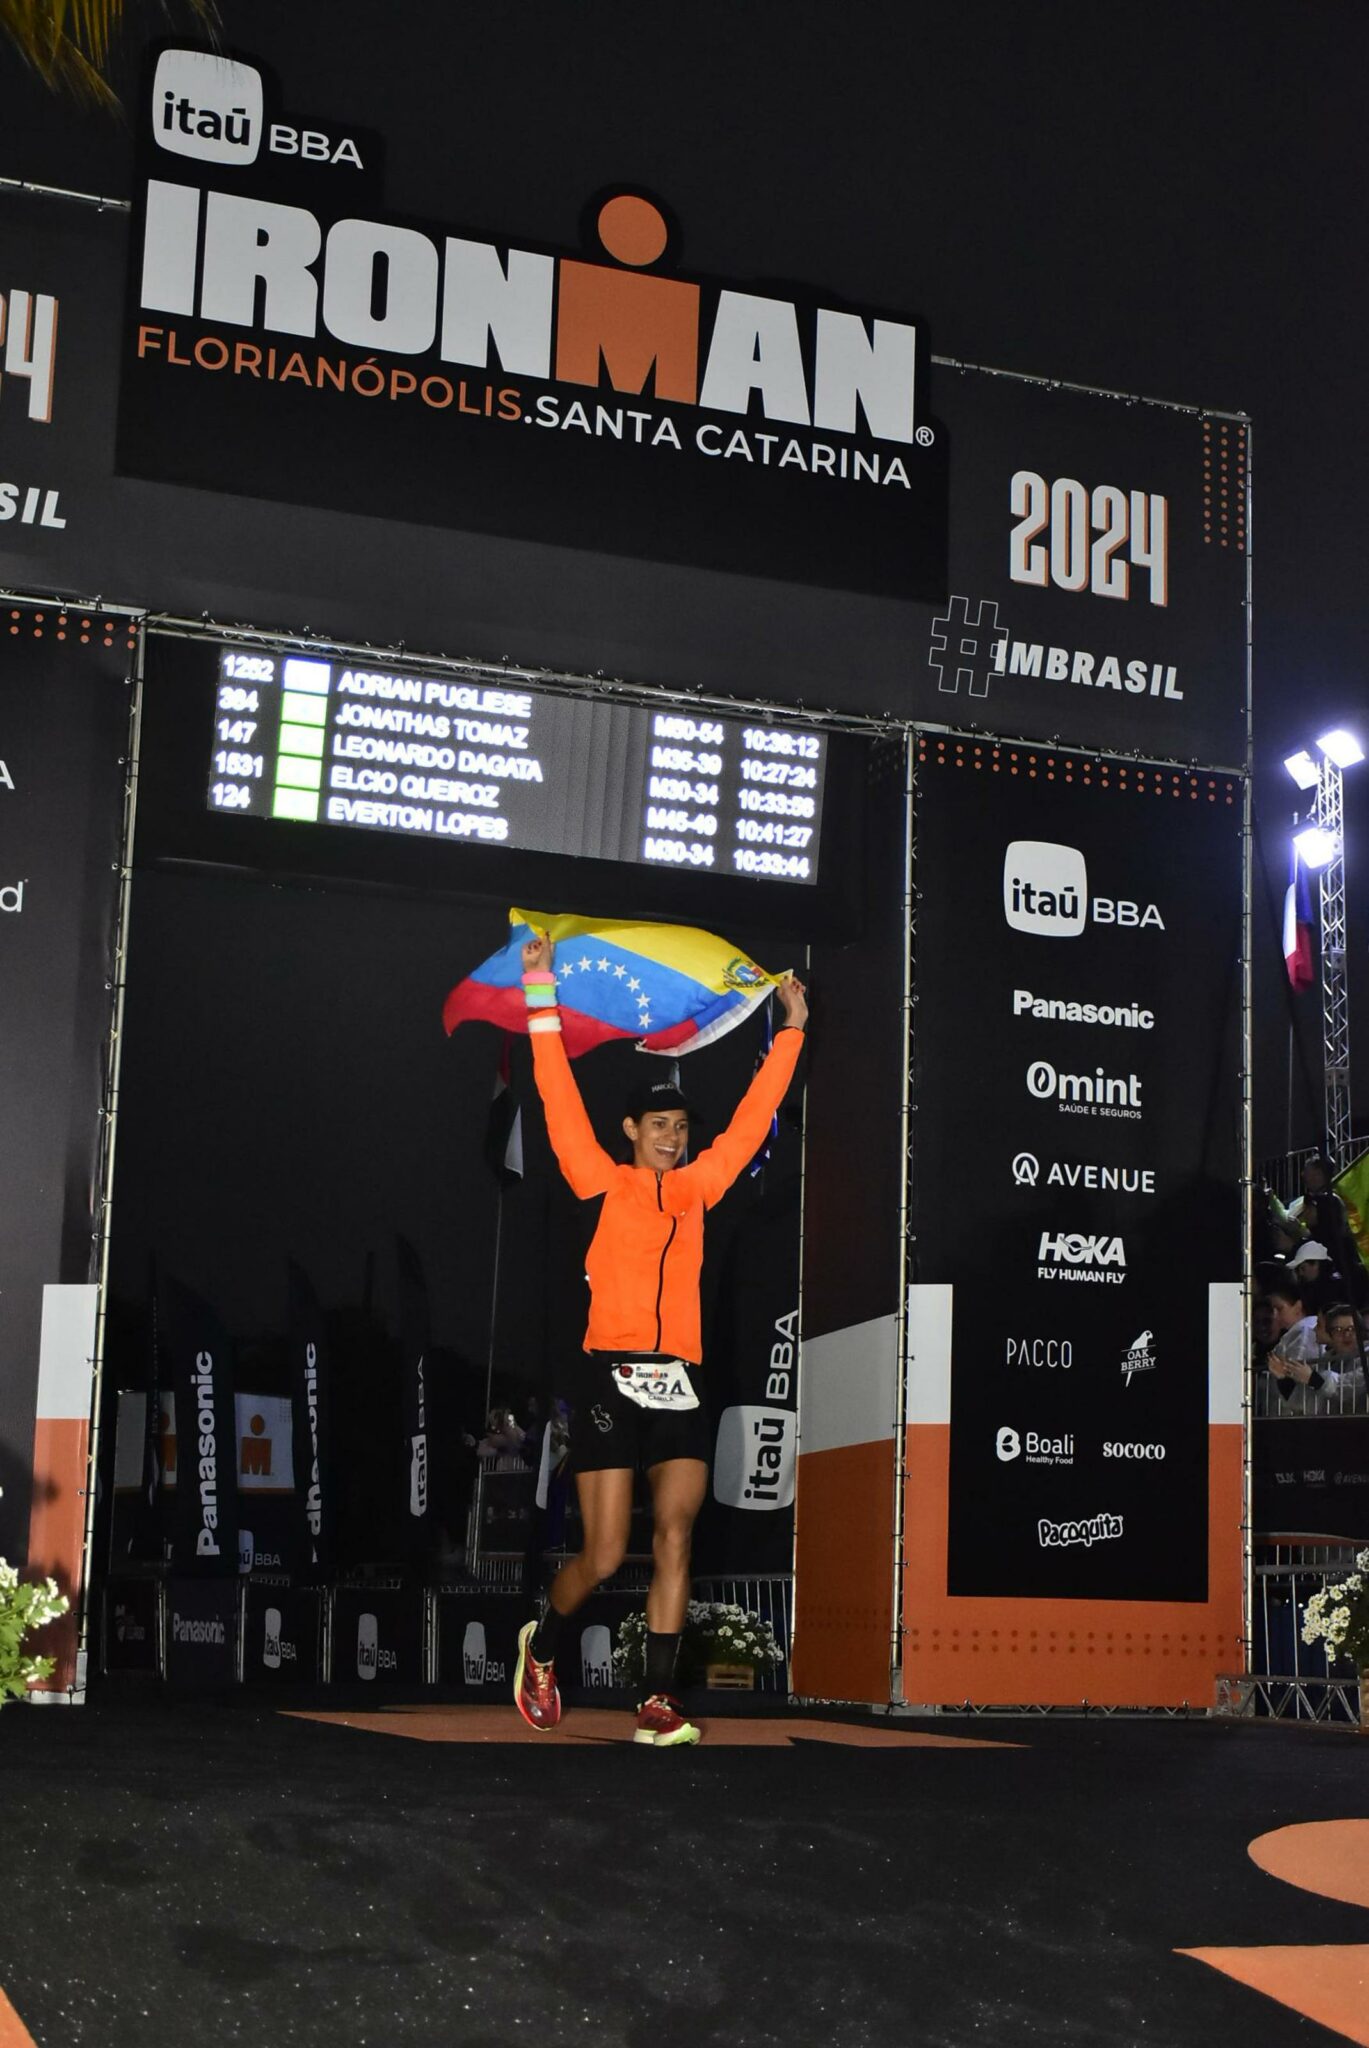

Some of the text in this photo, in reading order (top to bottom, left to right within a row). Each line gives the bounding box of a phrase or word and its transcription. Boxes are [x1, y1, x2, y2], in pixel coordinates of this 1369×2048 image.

[269, 125, 364, 169] BBA
[140, 178, 917, 445] IRONMAN
[695, 424, 912, 490] CATARINA
[1009, 470, 1168, 608] 2024
[336, 671, 422, 703] ADRIAN
[335, 703, 451, 739] JONATHAS
[452, 717, 529, 750] TOMAZ
[217, 718, 258, 744] 147
[332, 734, 455, 771] LEONARDO
[458, 750, 544, 783] DAGATA
[211, 782, 252, 810] 124
[327, 797, 432, 832] EVERTON
[434, 810, 510, 841] LOPES
[330, 765, 398, 795] ELCIO
[400, 775, 500, 809] QUEIROZ
[735, 819, 813, 849] 10:41:27
[1011, 877, 1166, 930] itaú BBA
[1012, 988, 1155, 1030] Panasonic
[1099, 1107, 1143, 1120] SEGUROS
[1046, 1162, 1156, 1194] AVENUE
[1037, 1231, 1127, 1267] HOKA
[1037, 1267, 1127, 1285] FLY HUMAN FLY
[765, 1308, 799, 1401] BBA
[1006, 1337, 1073, 1369] PACCO
[1120, 1356, 1157, 1372] BERRY
[1126, 1350, 1150, 1361] OAK
[191, 1350, 221, 1556] Panasonic
[1025, 1432, 1074, 1456] Boali
[1025, 1454, 1074, 1466] Healthy Food
[1102, 1441, 1166, 1461] sococo
[255, 1553, 281, 1566] BBA
[172, 1612, 226, 1645] Panasonic
[281, 1641, 297, 1660] BBA
[378, 1649, 398, 1670] BBA
[486, 1660, 506, 1683] BBA
